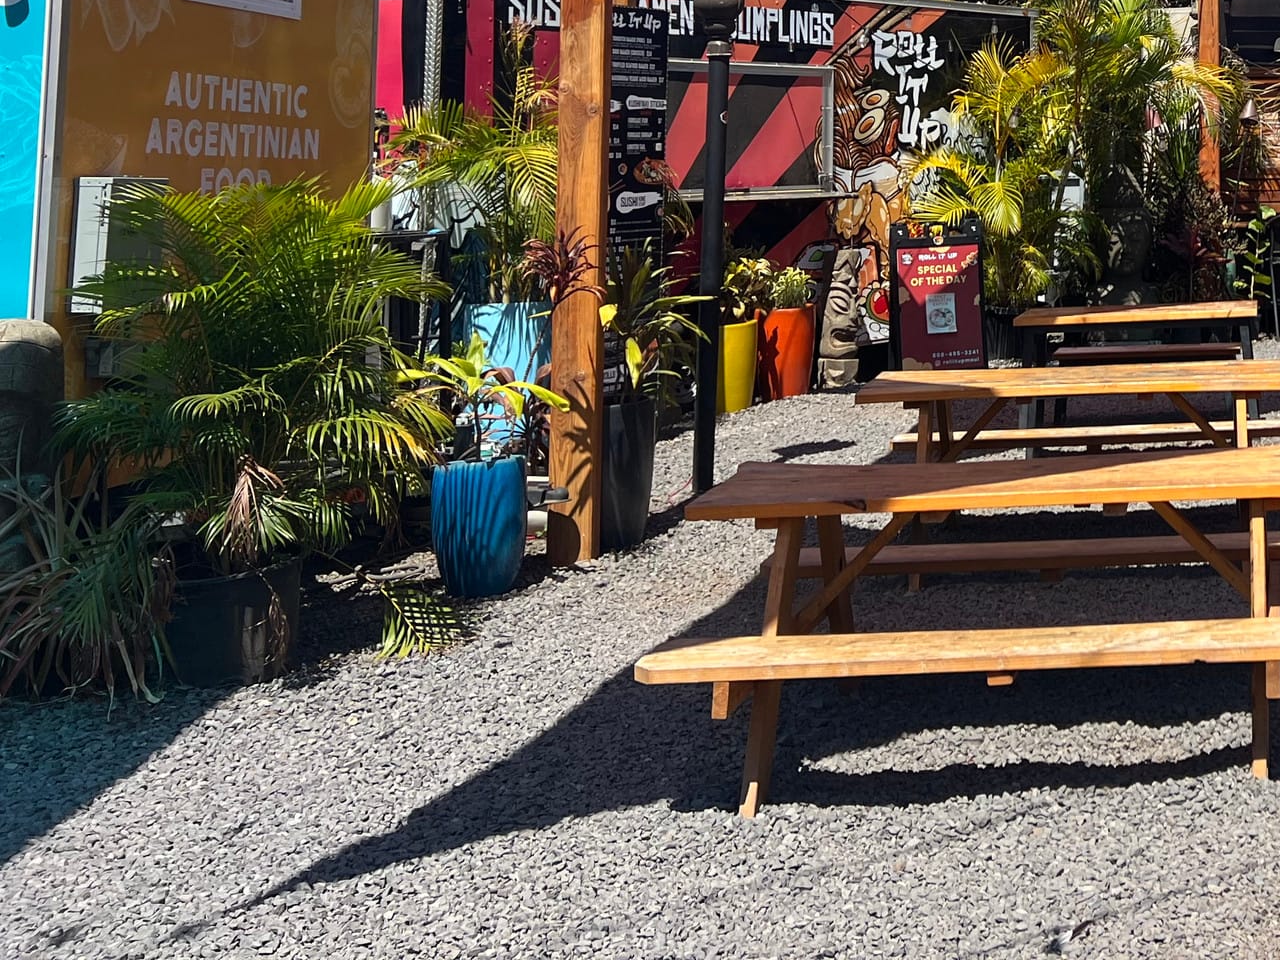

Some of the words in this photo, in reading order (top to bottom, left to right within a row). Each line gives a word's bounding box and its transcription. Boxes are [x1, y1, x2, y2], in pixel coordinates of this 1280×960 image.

[731, 6, 834, 46] UMPLINGS
[164, 71, 309, 118] AUTHENTIC
[145, 117, 320, 160] ARGENTINIAN
[910, 277, 924, 287] OF
[925, 276, 945, 286] THE
[946, 275, 967, 285] DAY
[917, 263, 957, 275] SPECIAL
